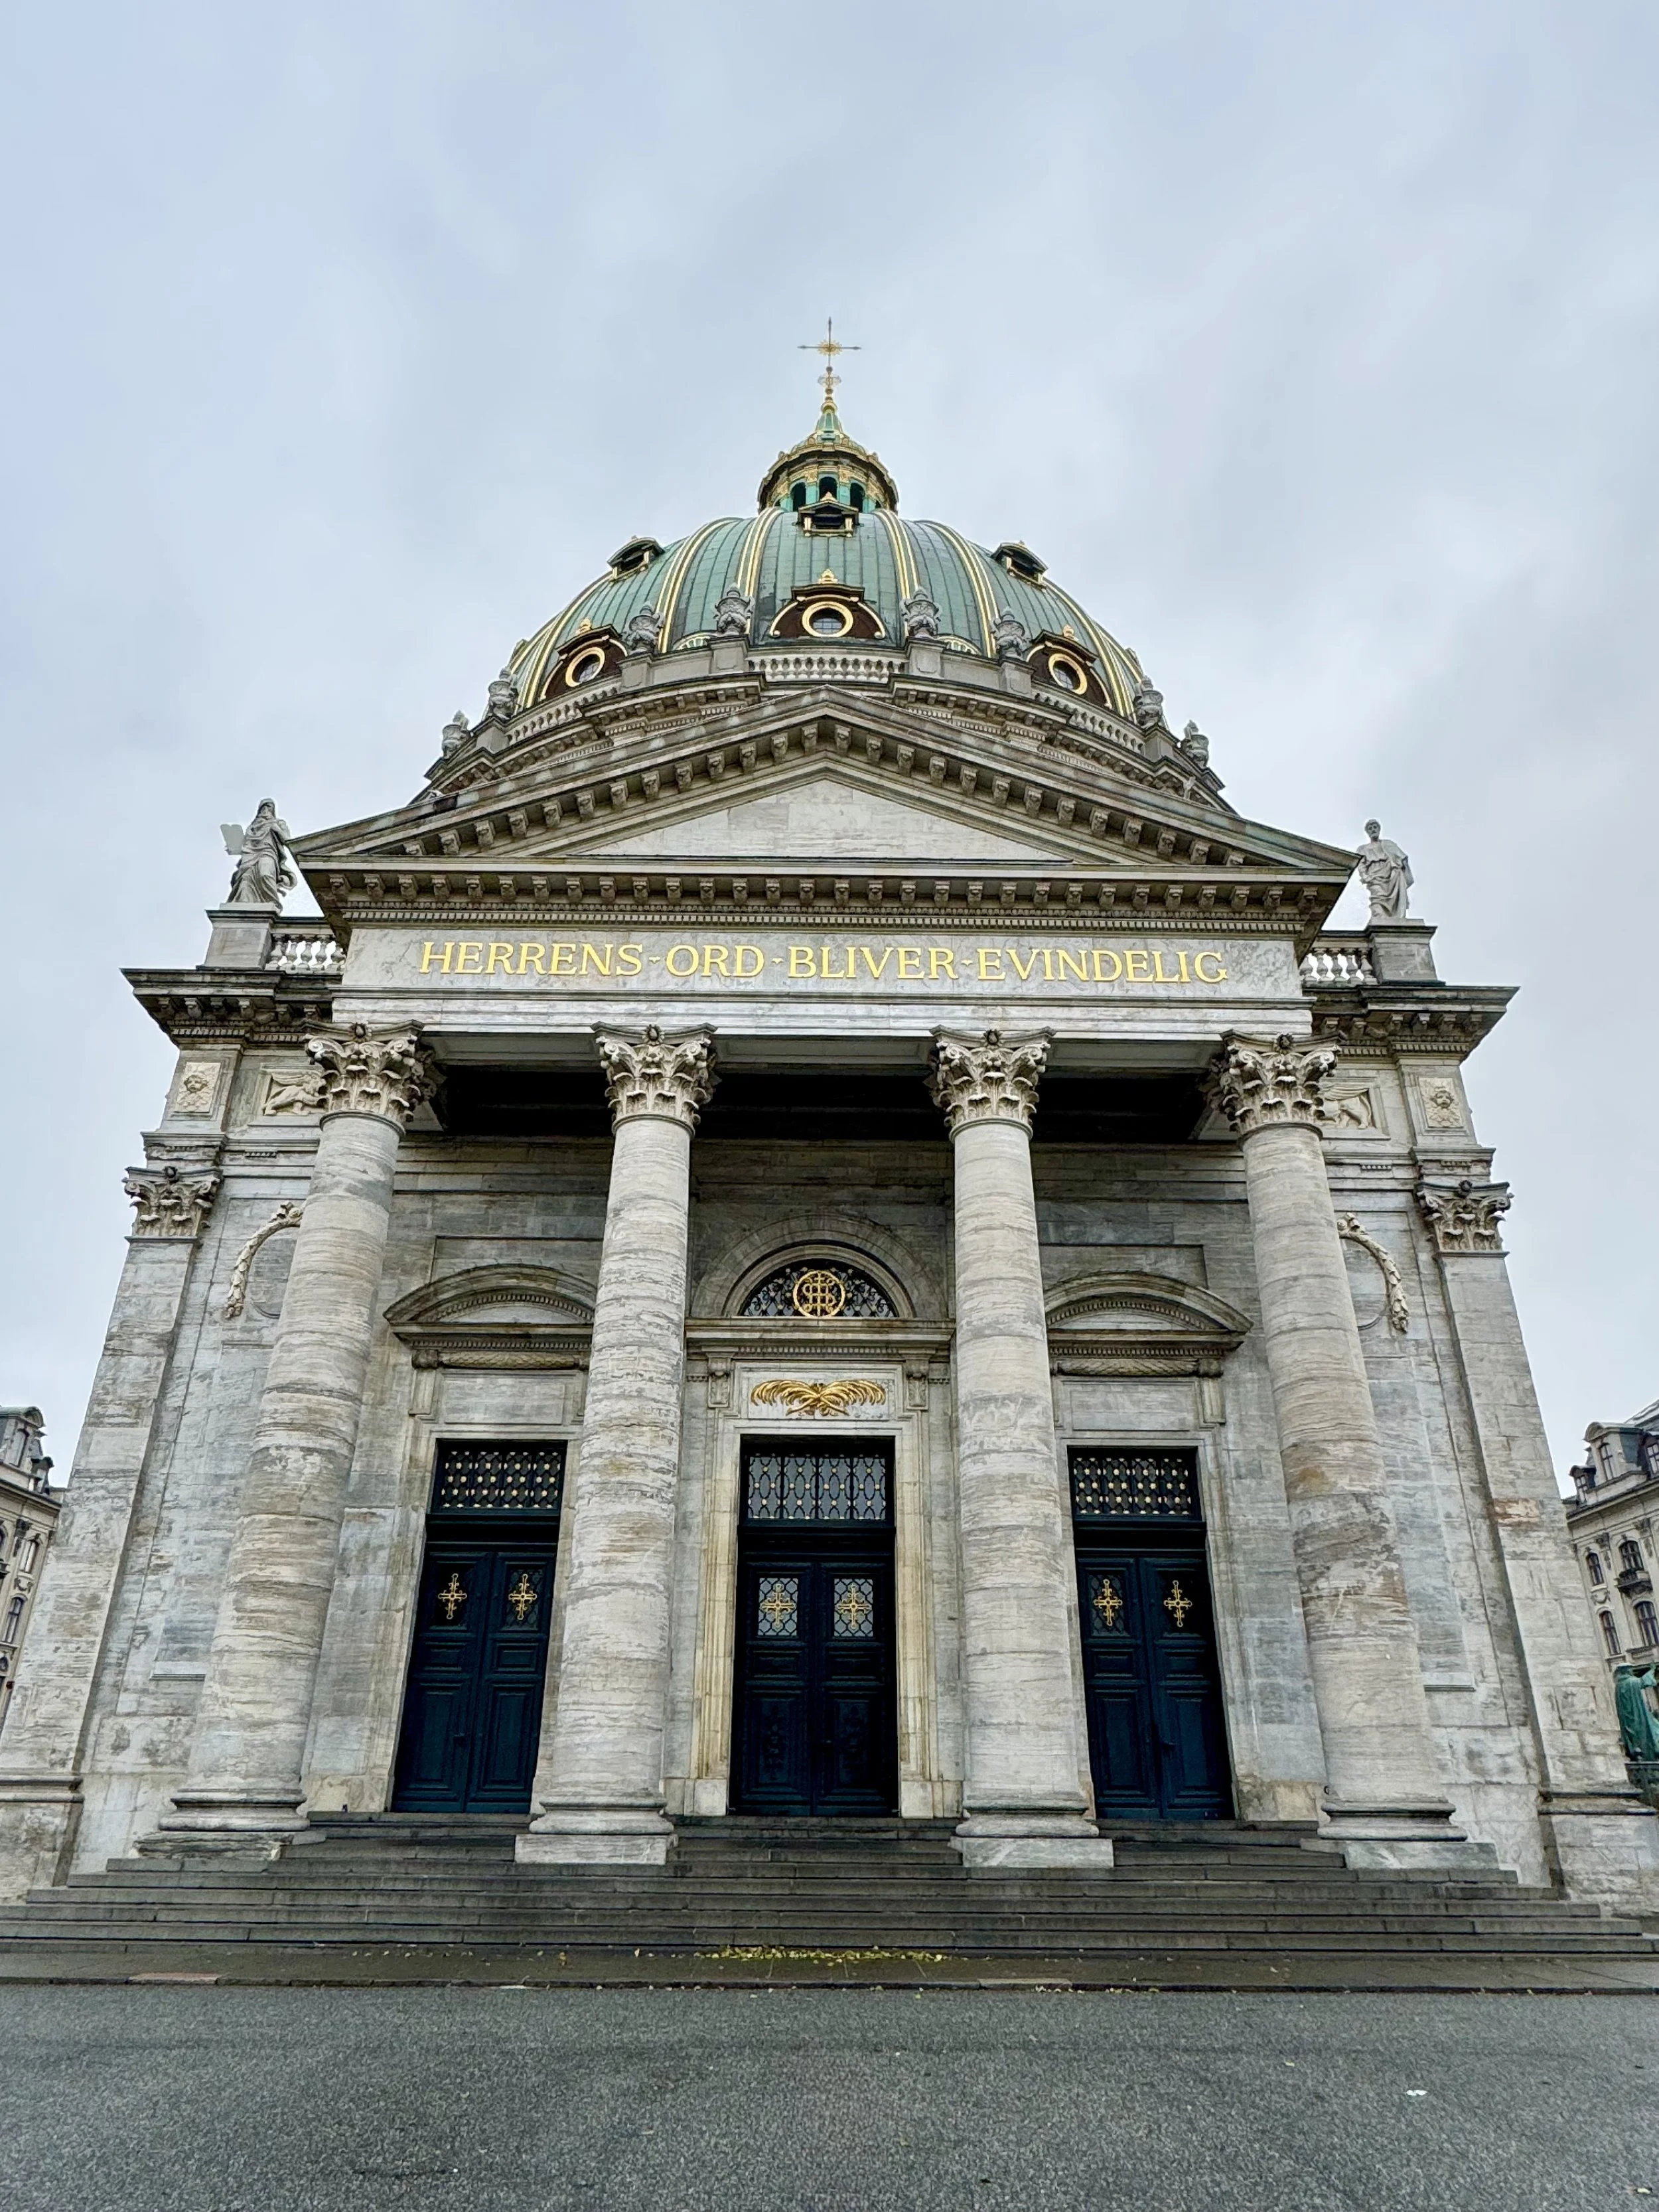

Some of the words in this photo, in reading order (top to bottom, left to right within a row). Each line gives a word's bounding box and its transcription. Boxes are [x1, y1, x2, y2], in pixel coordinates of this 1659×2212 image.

[419, 940, 644, 977] HERRENS
[665, 944, 764, 978] ORD
[787, 946, 959, 980] BLIVER
[977, 948, 1229, 984] EVINDELIG
